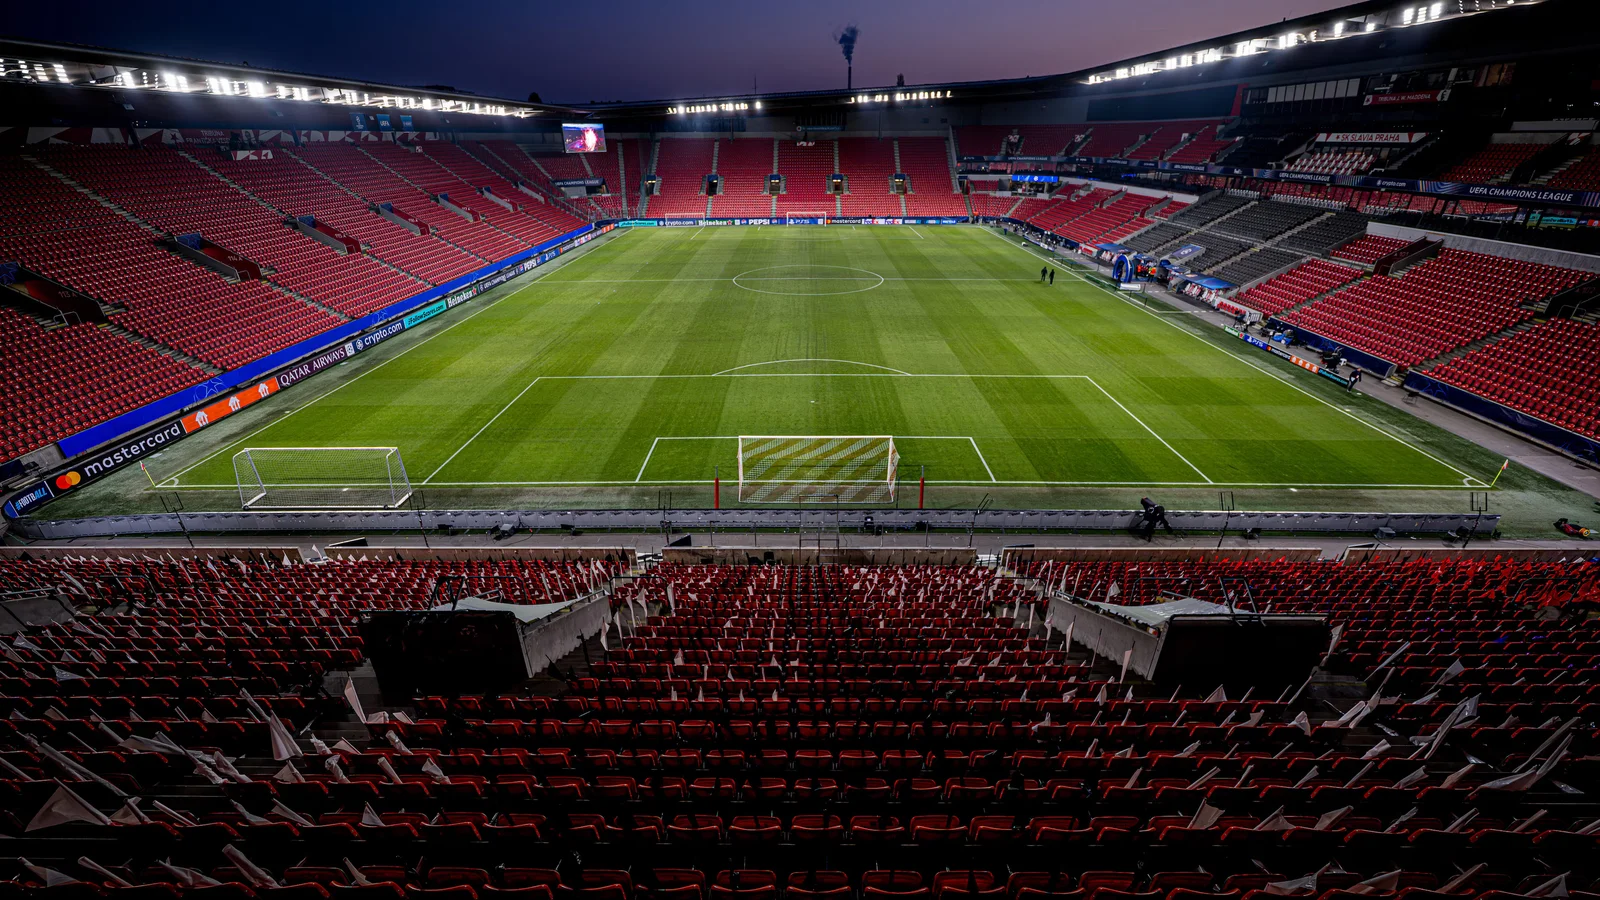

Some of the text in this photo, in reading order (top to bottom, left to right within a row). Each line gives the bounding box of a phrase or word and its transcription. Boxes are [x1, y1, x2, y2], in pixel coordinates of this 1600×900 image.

[1351, 133, 1373, 141] SLAVIA
[1290, 173, 1313, 181] CHAMPIONS
[1469, 186, 1574, 202] UEFA CHAMPIONS LEAGUE
[523, 259, 538, 271] PEPSI
[447, 290, 473, 308] Heineken
[364, 322, 403, 346] crypto.com
[280, 347, 345, 387] QATAR AIRWAYS
[84, 423, 181, 478] mastercard
[14, 486, 47, 511] #FOOTBALL
